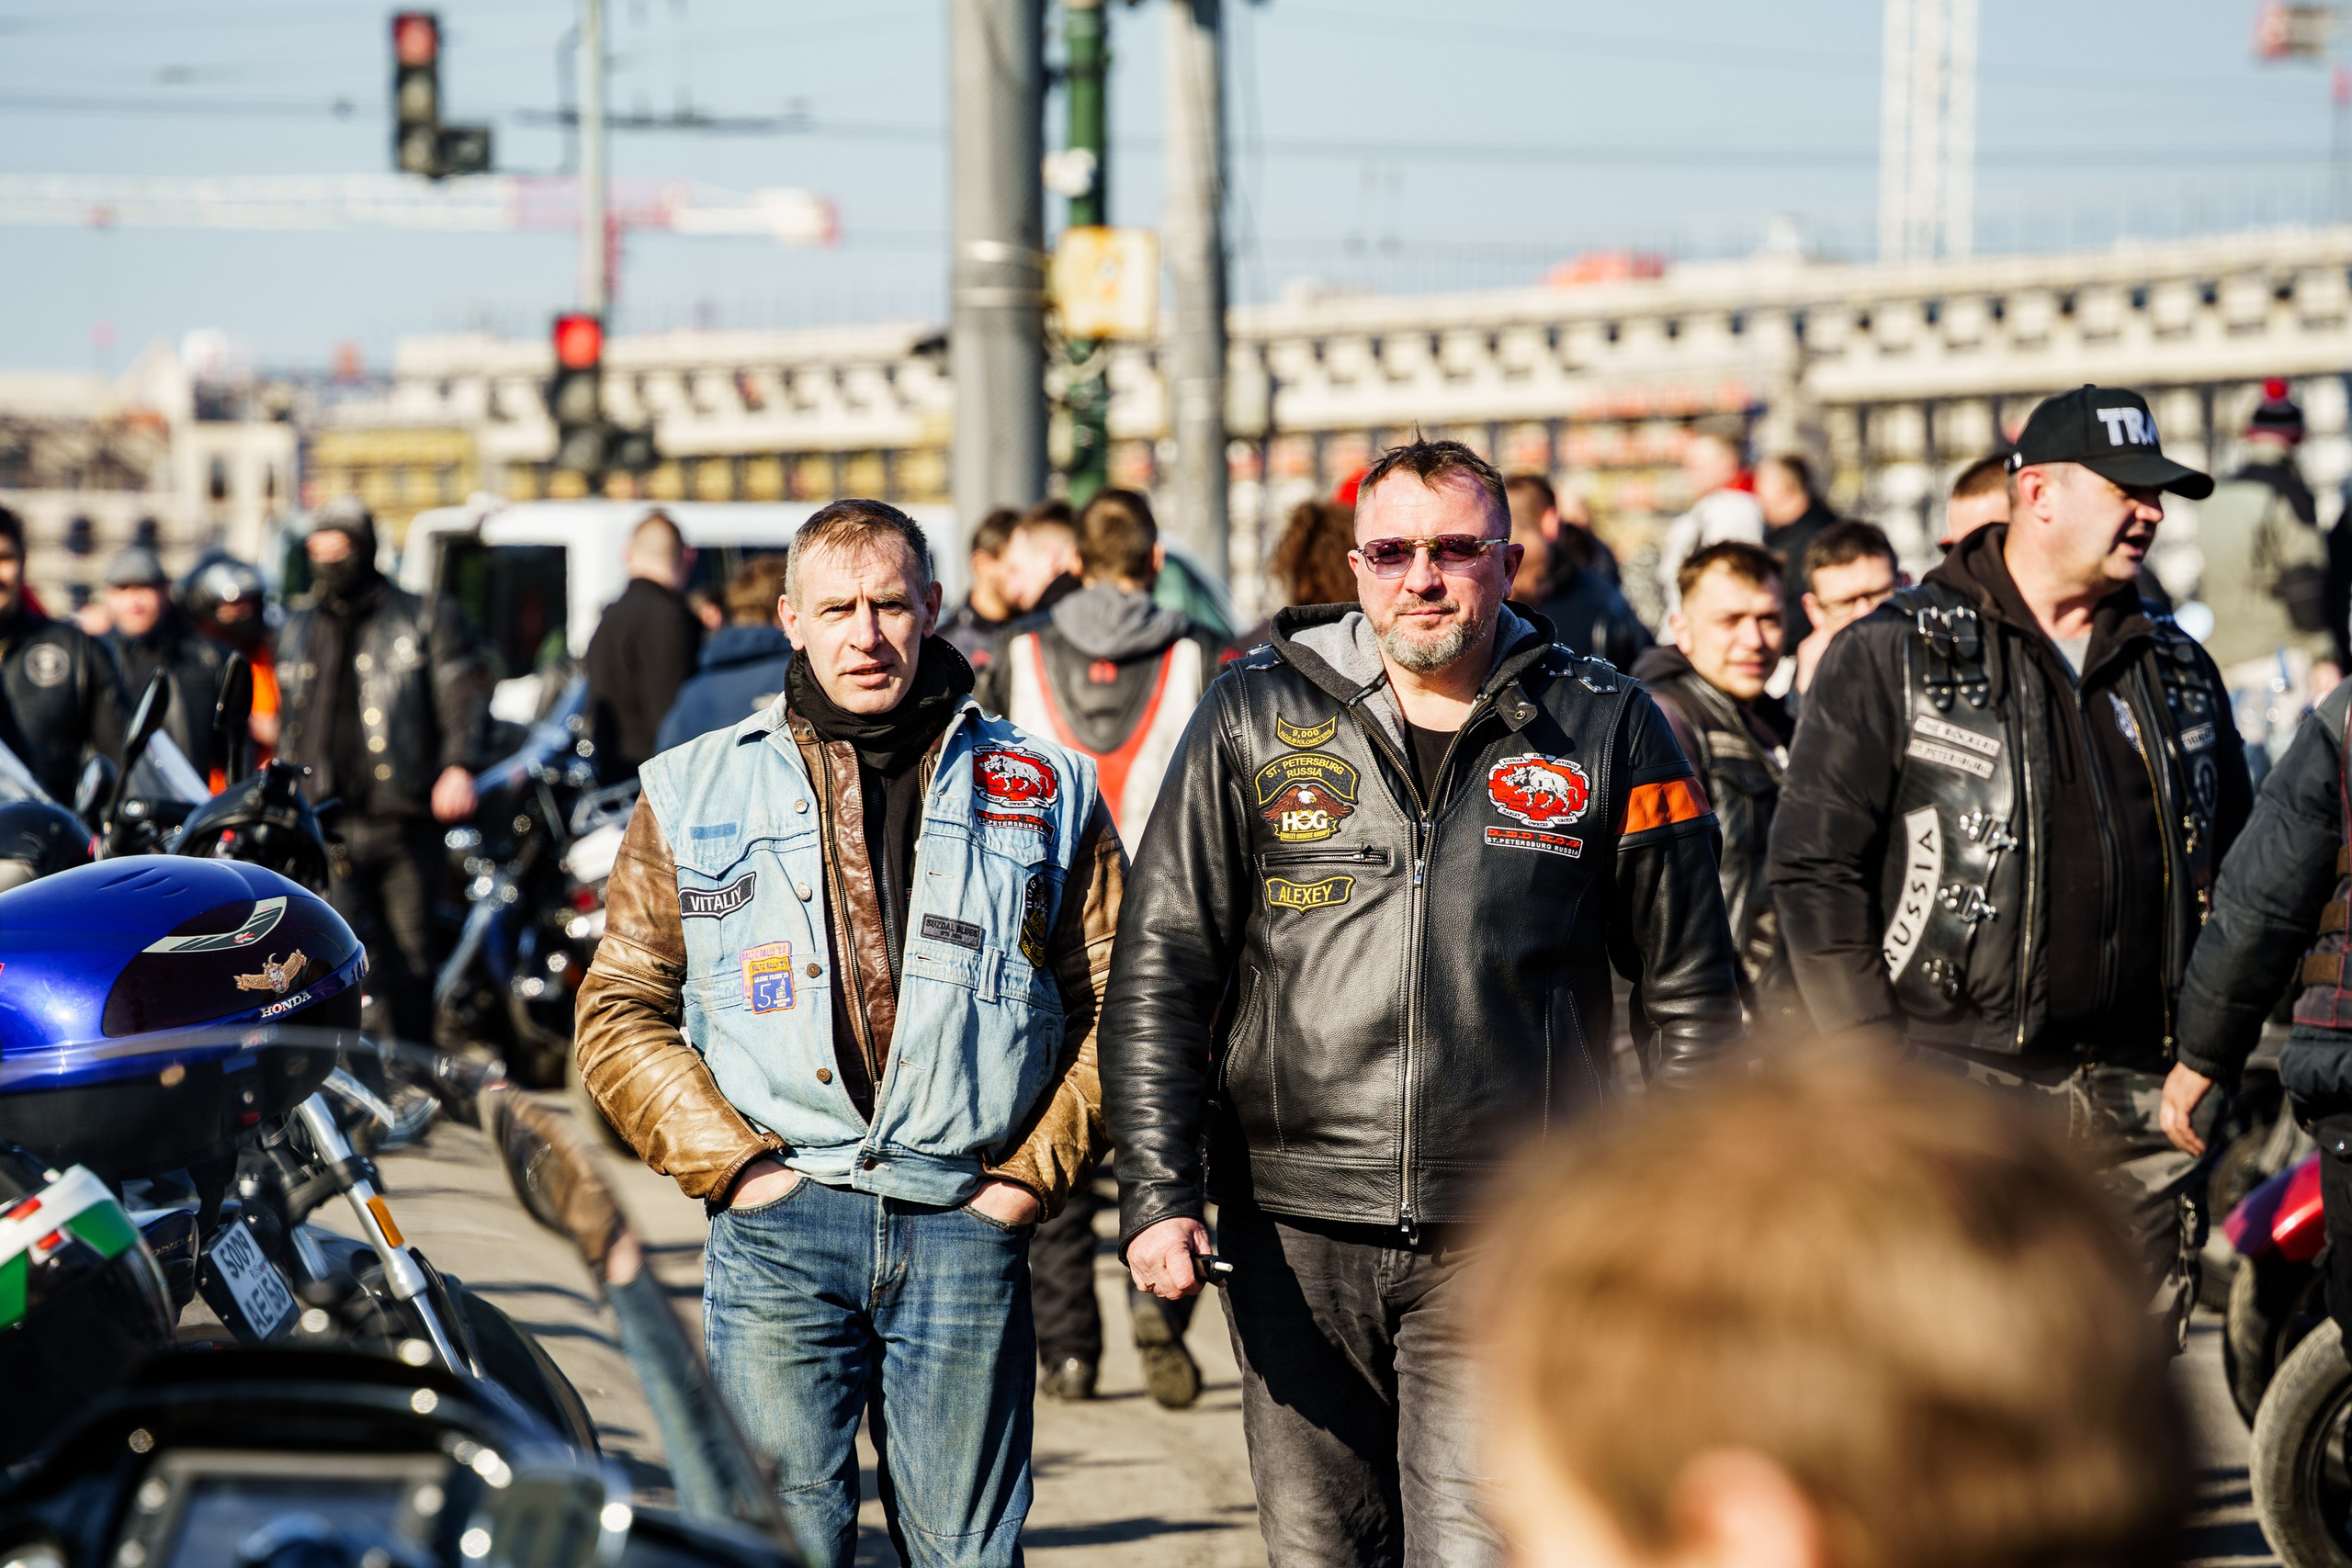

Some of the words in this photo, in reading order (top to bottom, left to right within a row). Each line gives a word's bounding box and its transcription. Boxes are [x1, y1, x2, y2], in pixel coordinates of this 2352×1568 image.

[1292, 729, 1319, 739] 9,000
[1265, 765, 1281, 779] ST.
[1282, 757, 1345, 775] PETERSBURG
[1286, 767, 1323, 779] RUSSIA
[1502, 808, 1521, 818] HARLEY
[1554, 845, 1578, 856] RUSSIA
[689, 886, 741, 911] VITALIY
[1278, 884, 1333, 905] ALEXEY
[1883, 829, 1936, 972] RUSSIA
[925, 918, 956, 932] SUZDAL
[956, 923, 979, 938] BLUES
[742, 950, 759, 961] BALTIC
[759, 948, 775, 958] RALLY
[752, 963, 766, 971] BALTIC
[260, 991, 312, 1019] HONDA
[758, 983, 771, 1008] 5
[151, 1234, 193, 1258] ONDA
[219, 1229, 257, 1280] 5009
